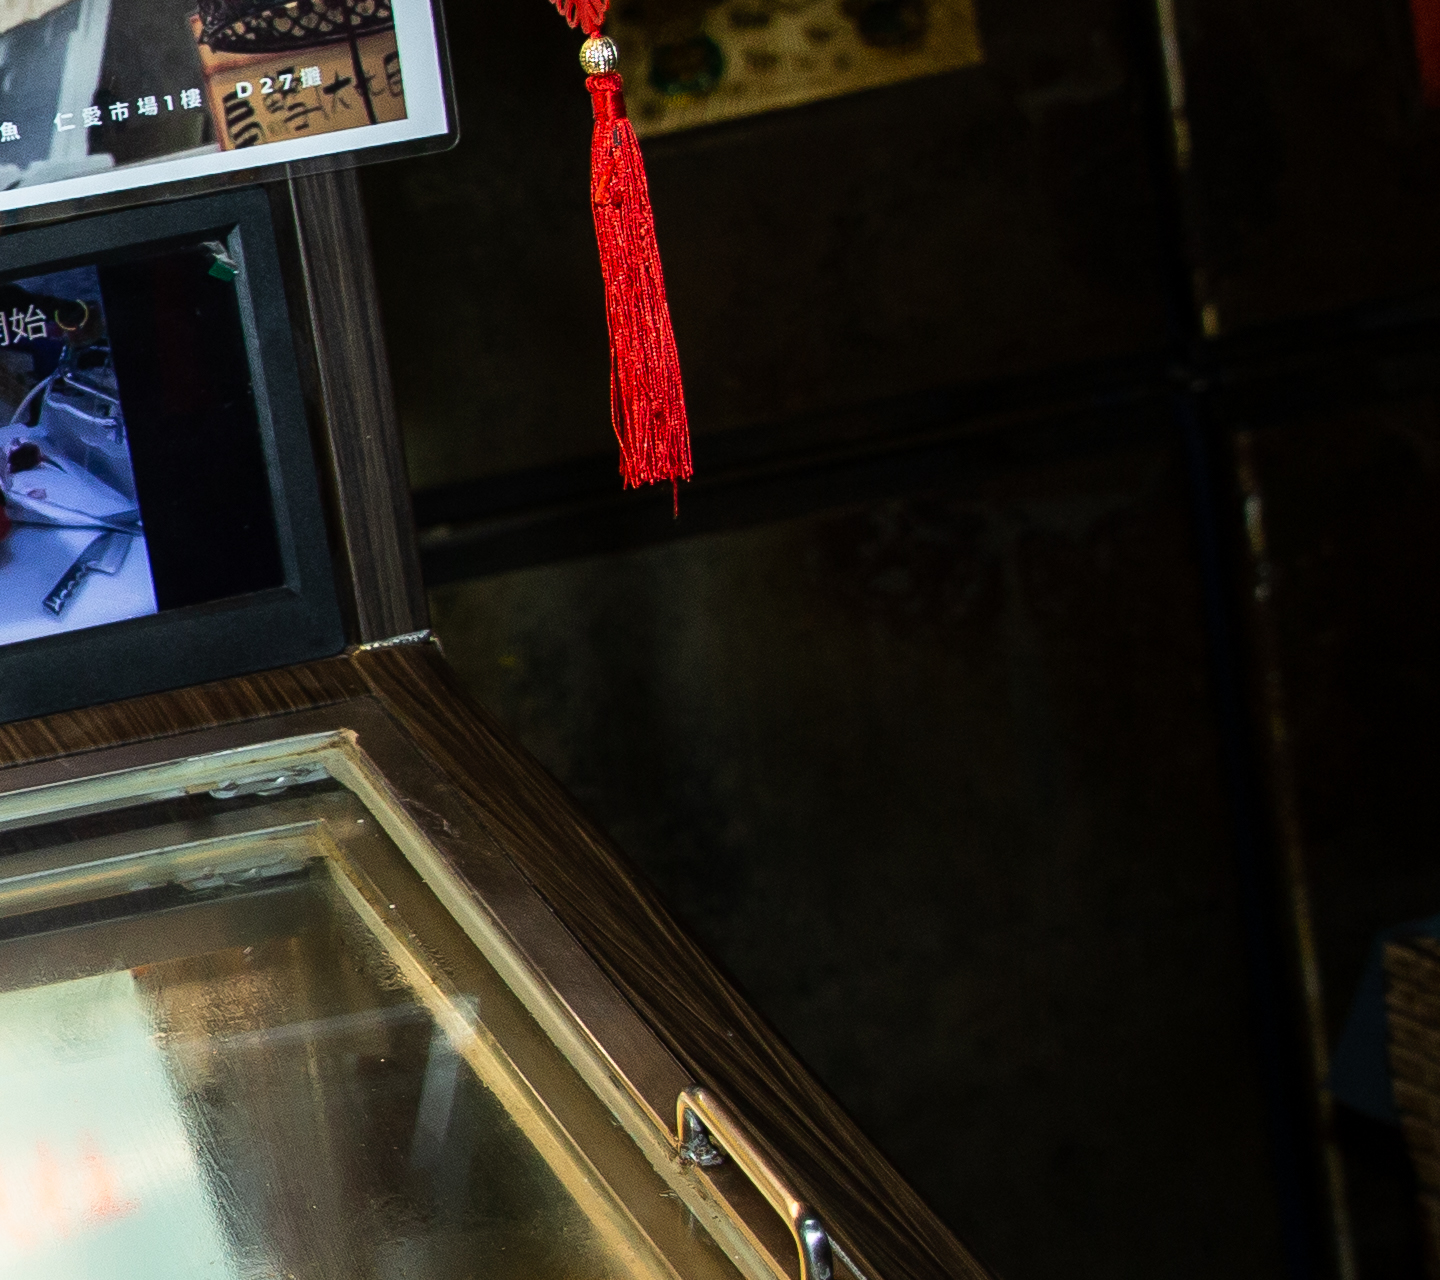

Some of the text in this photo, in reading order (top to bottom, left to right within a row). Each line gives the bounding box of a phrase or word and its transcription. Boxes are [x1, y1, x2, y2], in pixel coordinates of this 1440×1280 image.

[53, 87, 202, 133] 仁愛市場1樓
